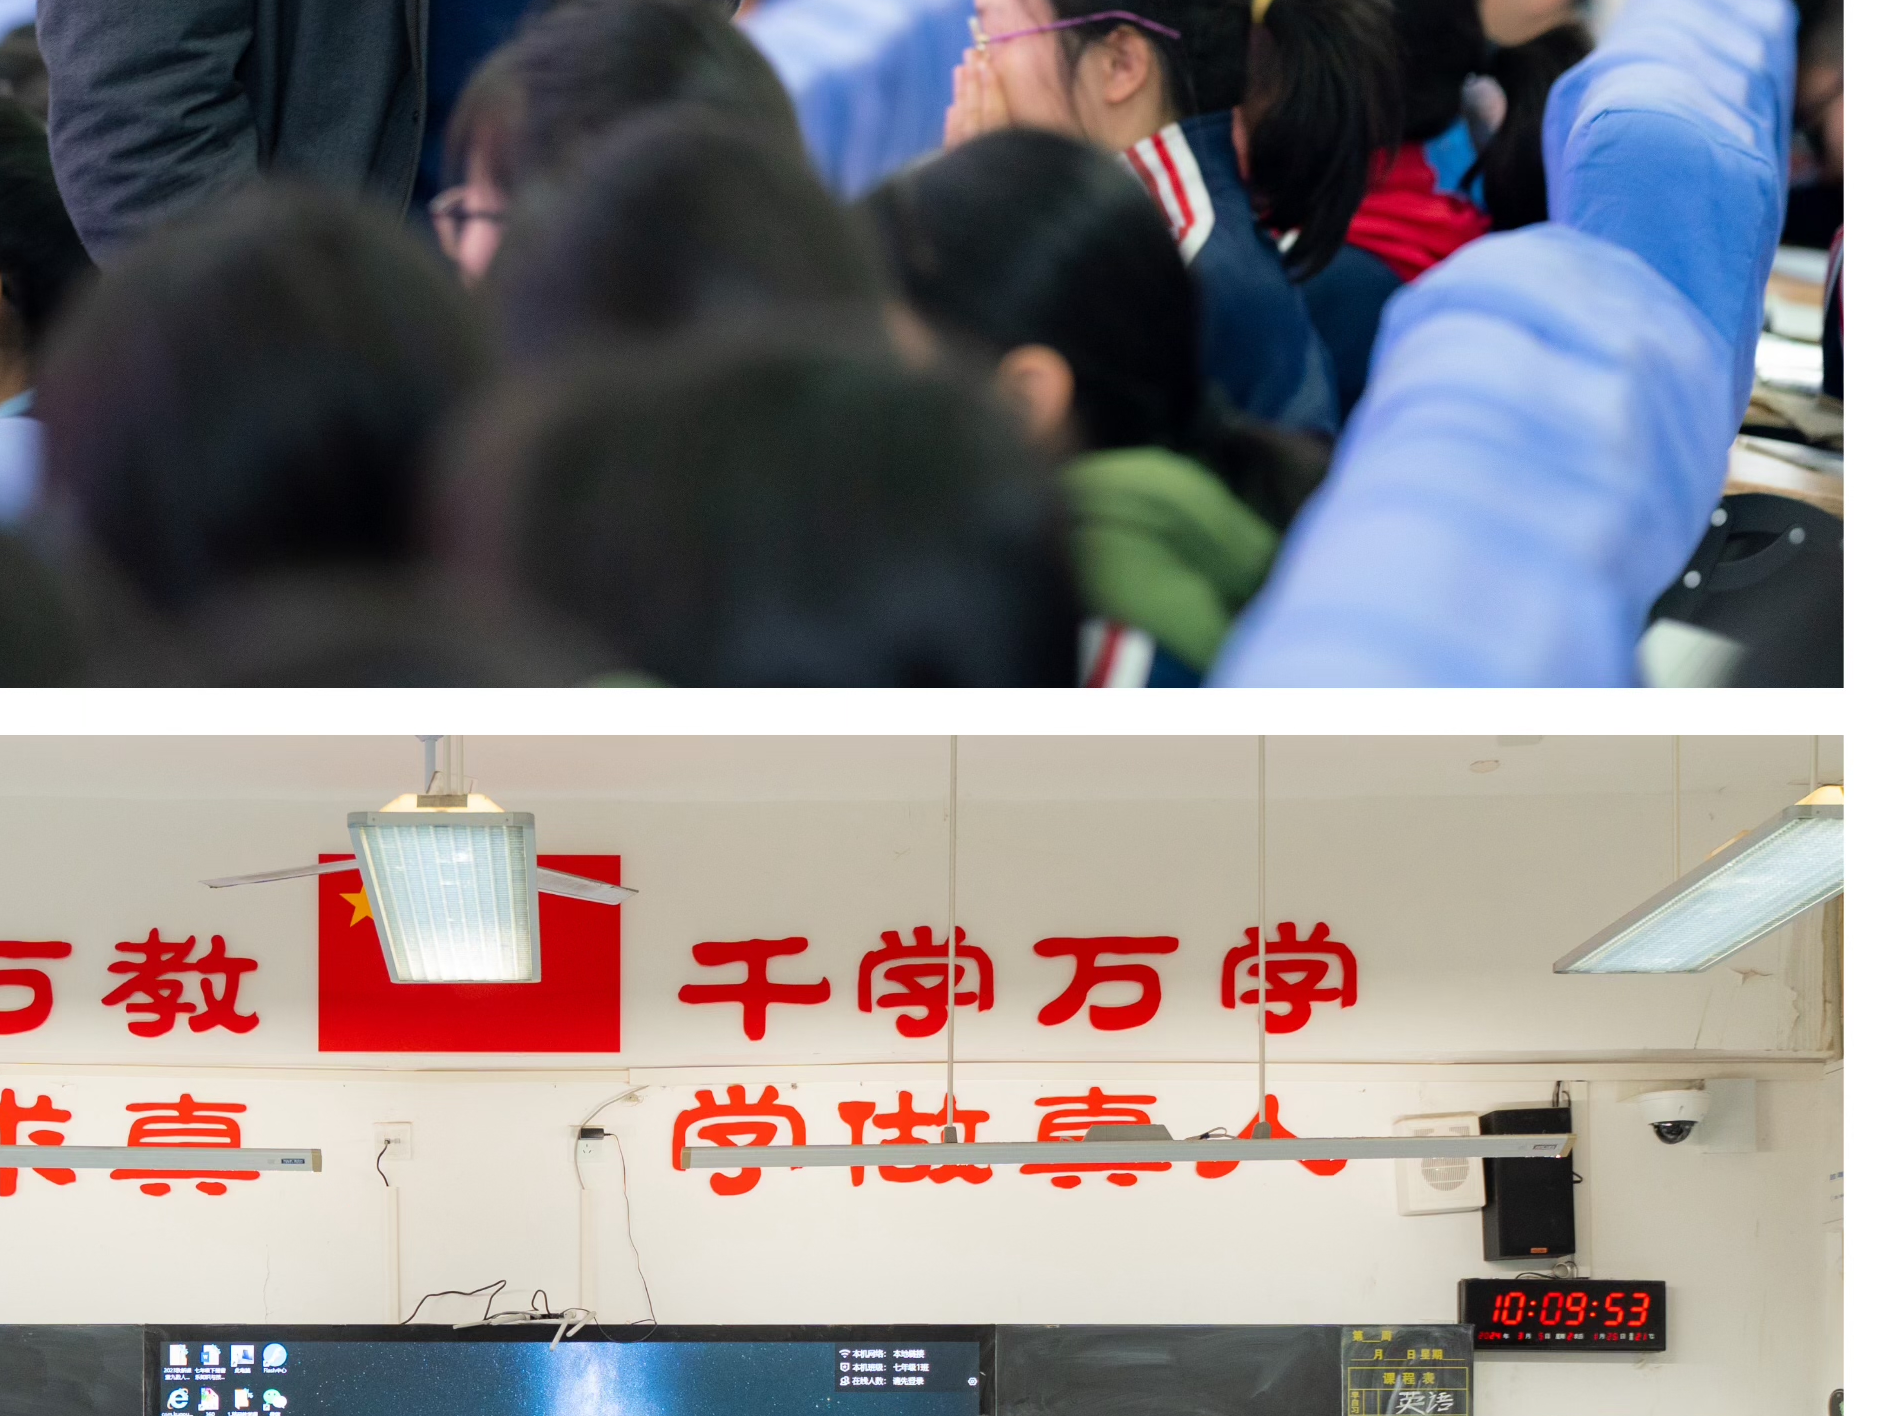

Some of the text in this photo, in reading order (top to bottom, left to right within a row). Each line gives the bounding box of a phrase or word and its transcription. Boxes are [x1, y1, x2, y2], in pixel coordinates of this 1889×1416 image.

[678, 923, 1357, 1040] 千学万学
[672, 1085, 1349, 1196] 学做真人
[1492, 1292, 1651, 1327] 10:09:53
[1395, 1391, 1454, 1415] 英语
